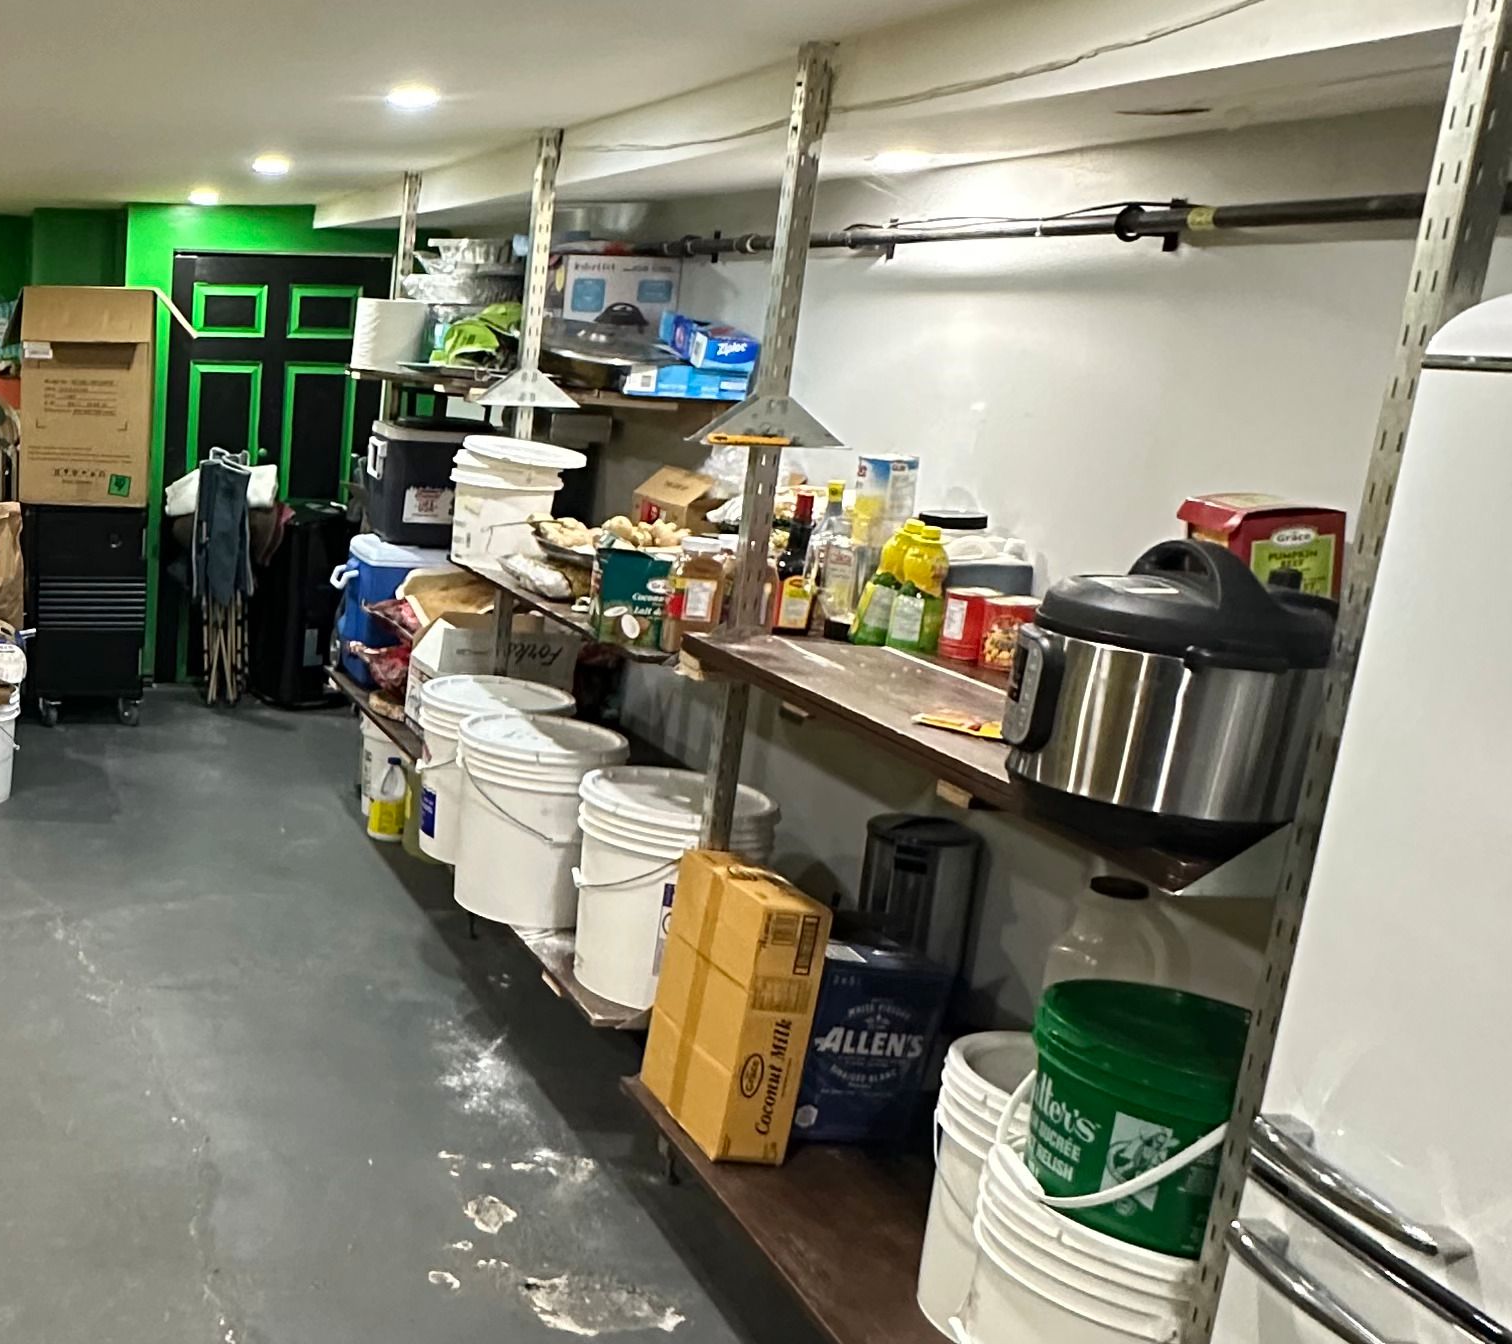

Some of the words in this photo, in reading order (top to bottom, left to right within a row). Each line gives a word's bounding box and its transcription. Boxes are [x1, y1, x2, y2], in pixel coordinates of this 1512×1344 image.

[716, 341, 748, 357] Ziploc
[1268, 550, 1318, 562] PUMPKIN
[814, 1026, 924, 1059] ALLEN'S
[755, 1063, 784, 1136] Coconut
[771, 1017, 793, 1063] Milk
